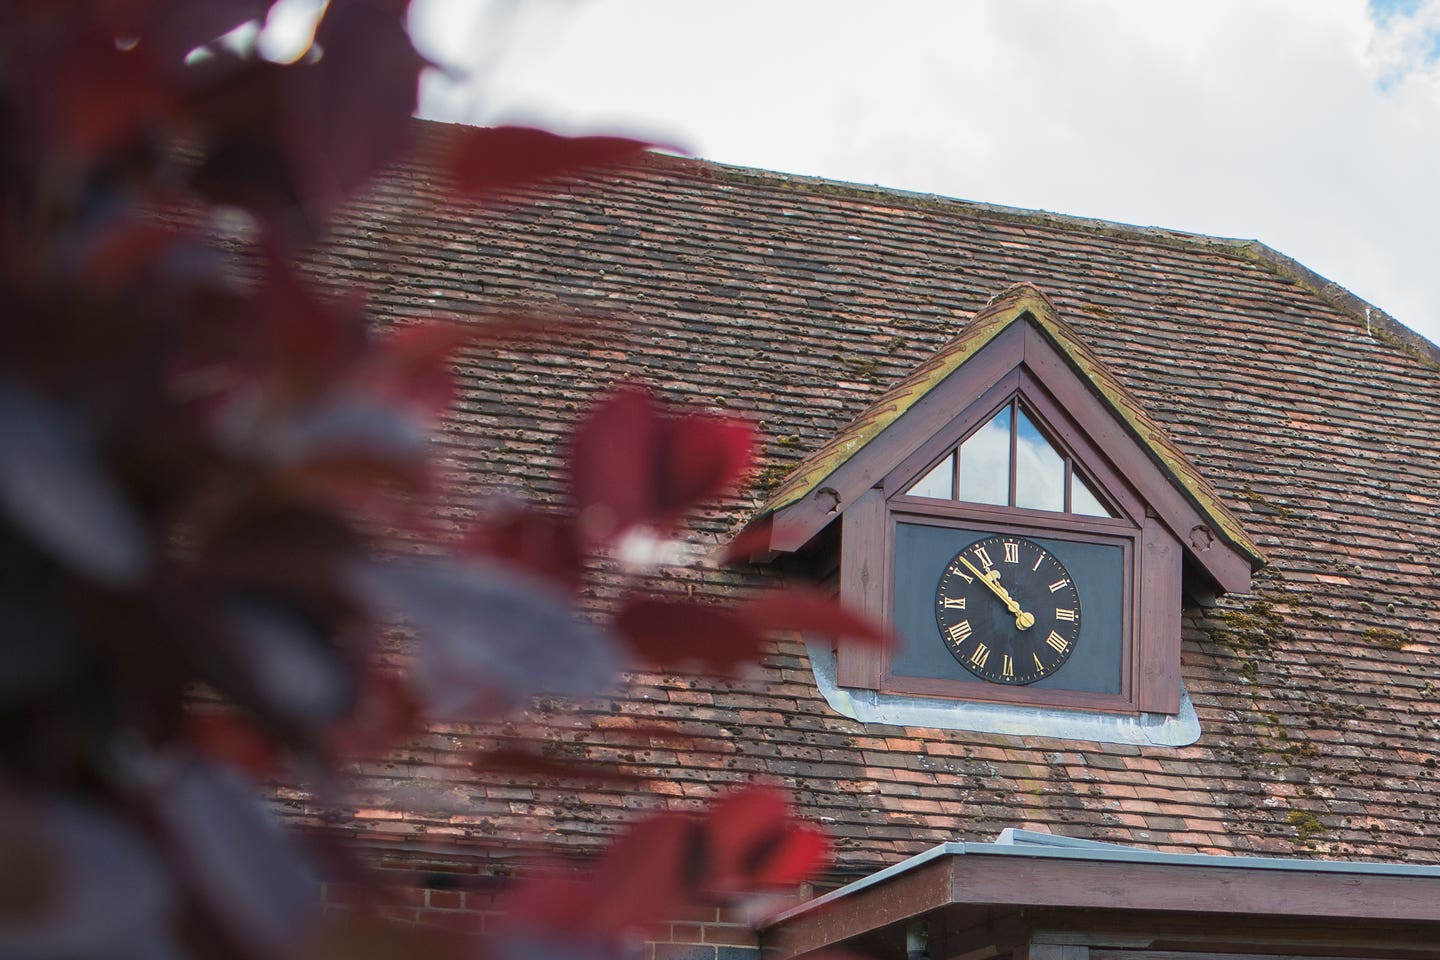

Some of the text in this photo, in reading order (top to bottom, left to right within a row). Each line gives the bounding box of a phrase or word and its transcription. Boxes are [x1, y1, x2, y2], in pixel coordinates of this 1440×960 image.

[974, 546, 994, 569] XI
[1004, 543, 1019, 563] XII
[1032, 554, 1045, 571] I
[953, 567, 974, 584] X
[1048, 578, 1068, 593] II
[944, 597, 966, 609] IX
[1055, 608, 1075, 622] III
[949, 619, 973, 646] VIII
[970, 642, 991, 669] VII
[1002, 654, 1014, 677] VI
[1032, 652, 1044, 672] V
